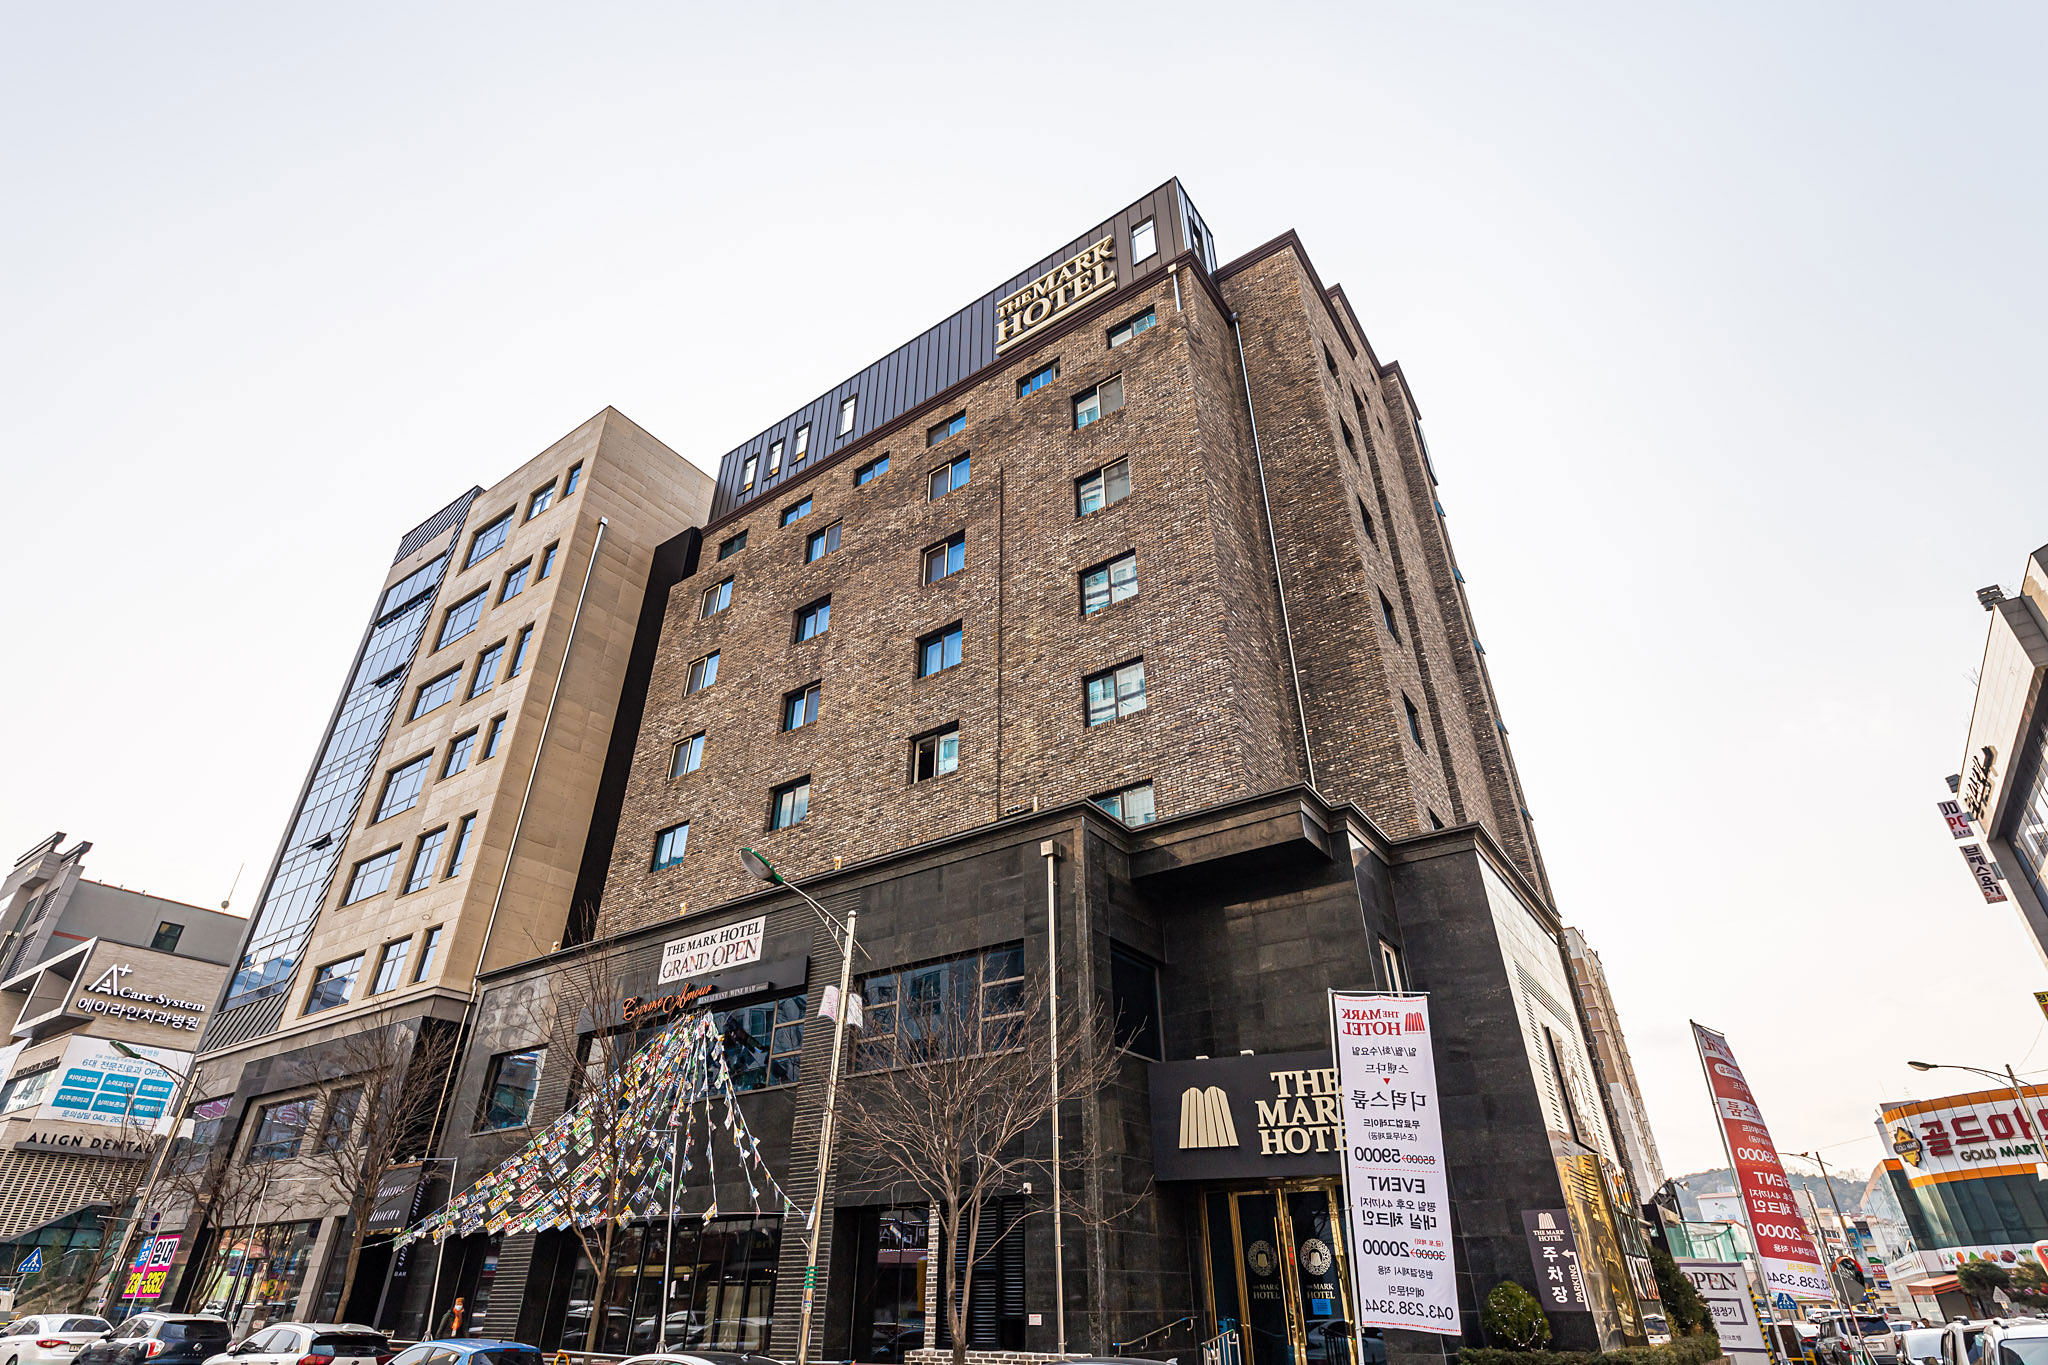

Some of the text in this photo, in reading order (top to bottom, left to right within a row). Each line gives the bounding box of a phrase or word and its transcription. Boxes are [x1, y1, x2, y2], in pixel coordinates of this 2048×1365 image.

[996, 239, 1113, 319] THE MARK
[996, 261, 1115, 345] HOTEL
[1942, 802, 1959, 815] JD
[1947, 815, 1968, 830] PC
[667, 921, 762, 957] THE MARK HOTEL
[662, 936, 760, 979] GRAND OPEN
[120, 986, 154, 1002] Care
[156, 993, 206, 1012] System
[77, 997, 200, 1031] 에이라인치과병원
[82, 1058, 97, 1068] 6대
[144, 1067, 169, 1078] OPEN
[1270, 1068, 1342, 1098] THE
[1255, 1096, 1345, 1127] MAR
[26, 1132, 155, 1154] ALIGN DENTAL
[1960, 1143, 2041, 1162] GOLD MART
[490, 1193, 508, 1208] OPEN
[488, 1214, 507, 1229] OPEN
[150, 1240, 177, 1265] 임대
[1542, 1246, 1568, 1304] 주차장
[1568, 1264, 1585, 1303] PARKING
[1253, 1291, 1280, 1299] HOTEL
[1307, 1291, 1335, 1299] HOTEL
[1710, 1306, 1737, 1317] 청정기
